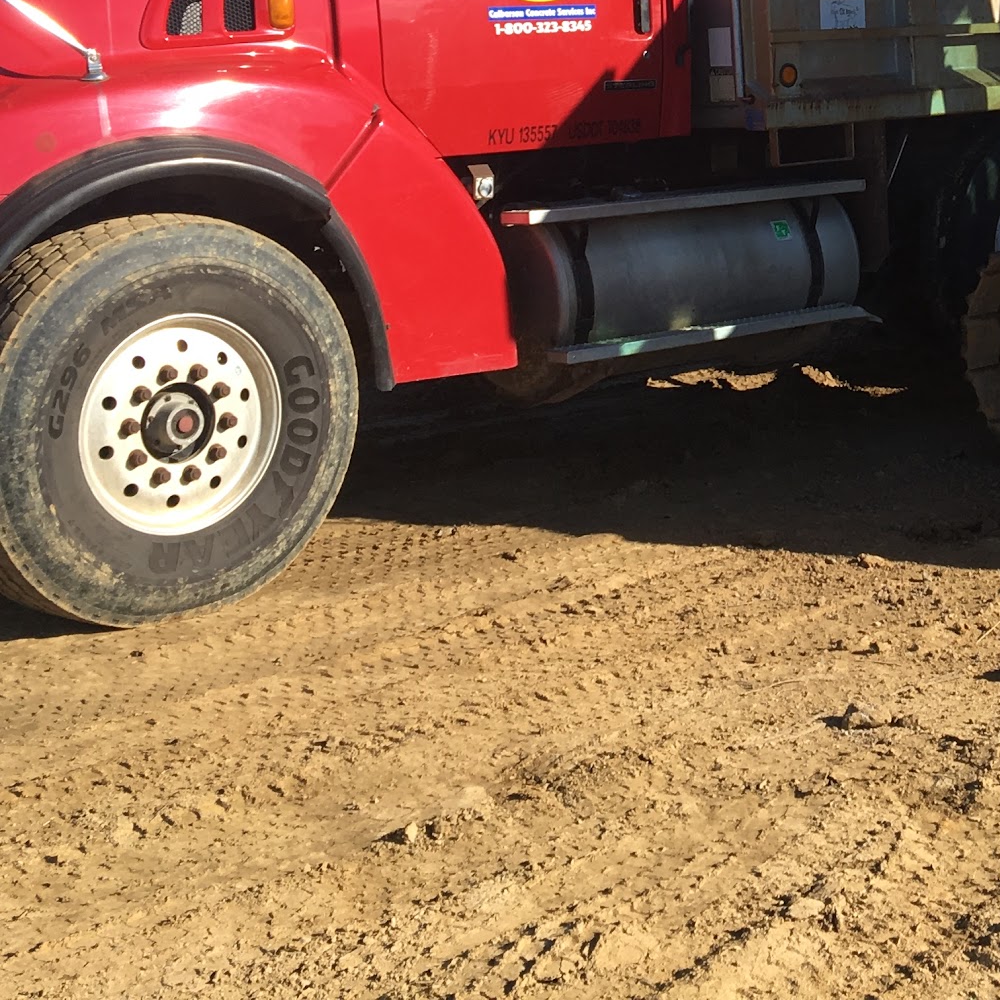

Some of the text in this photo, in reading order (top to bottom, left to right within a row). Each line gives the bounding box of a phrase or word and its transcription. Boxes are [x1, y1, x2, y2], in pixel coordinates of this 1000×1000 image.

[525, 8, 556, 18] Concrete
[557, 7, 584, 17] Services
[494, 20, 592, 35] 1-800-323-8345
[488, 128, 514, 145] KYU
[519, 124, 558, 143] 135557
[48, 345, 92, 440] G296
